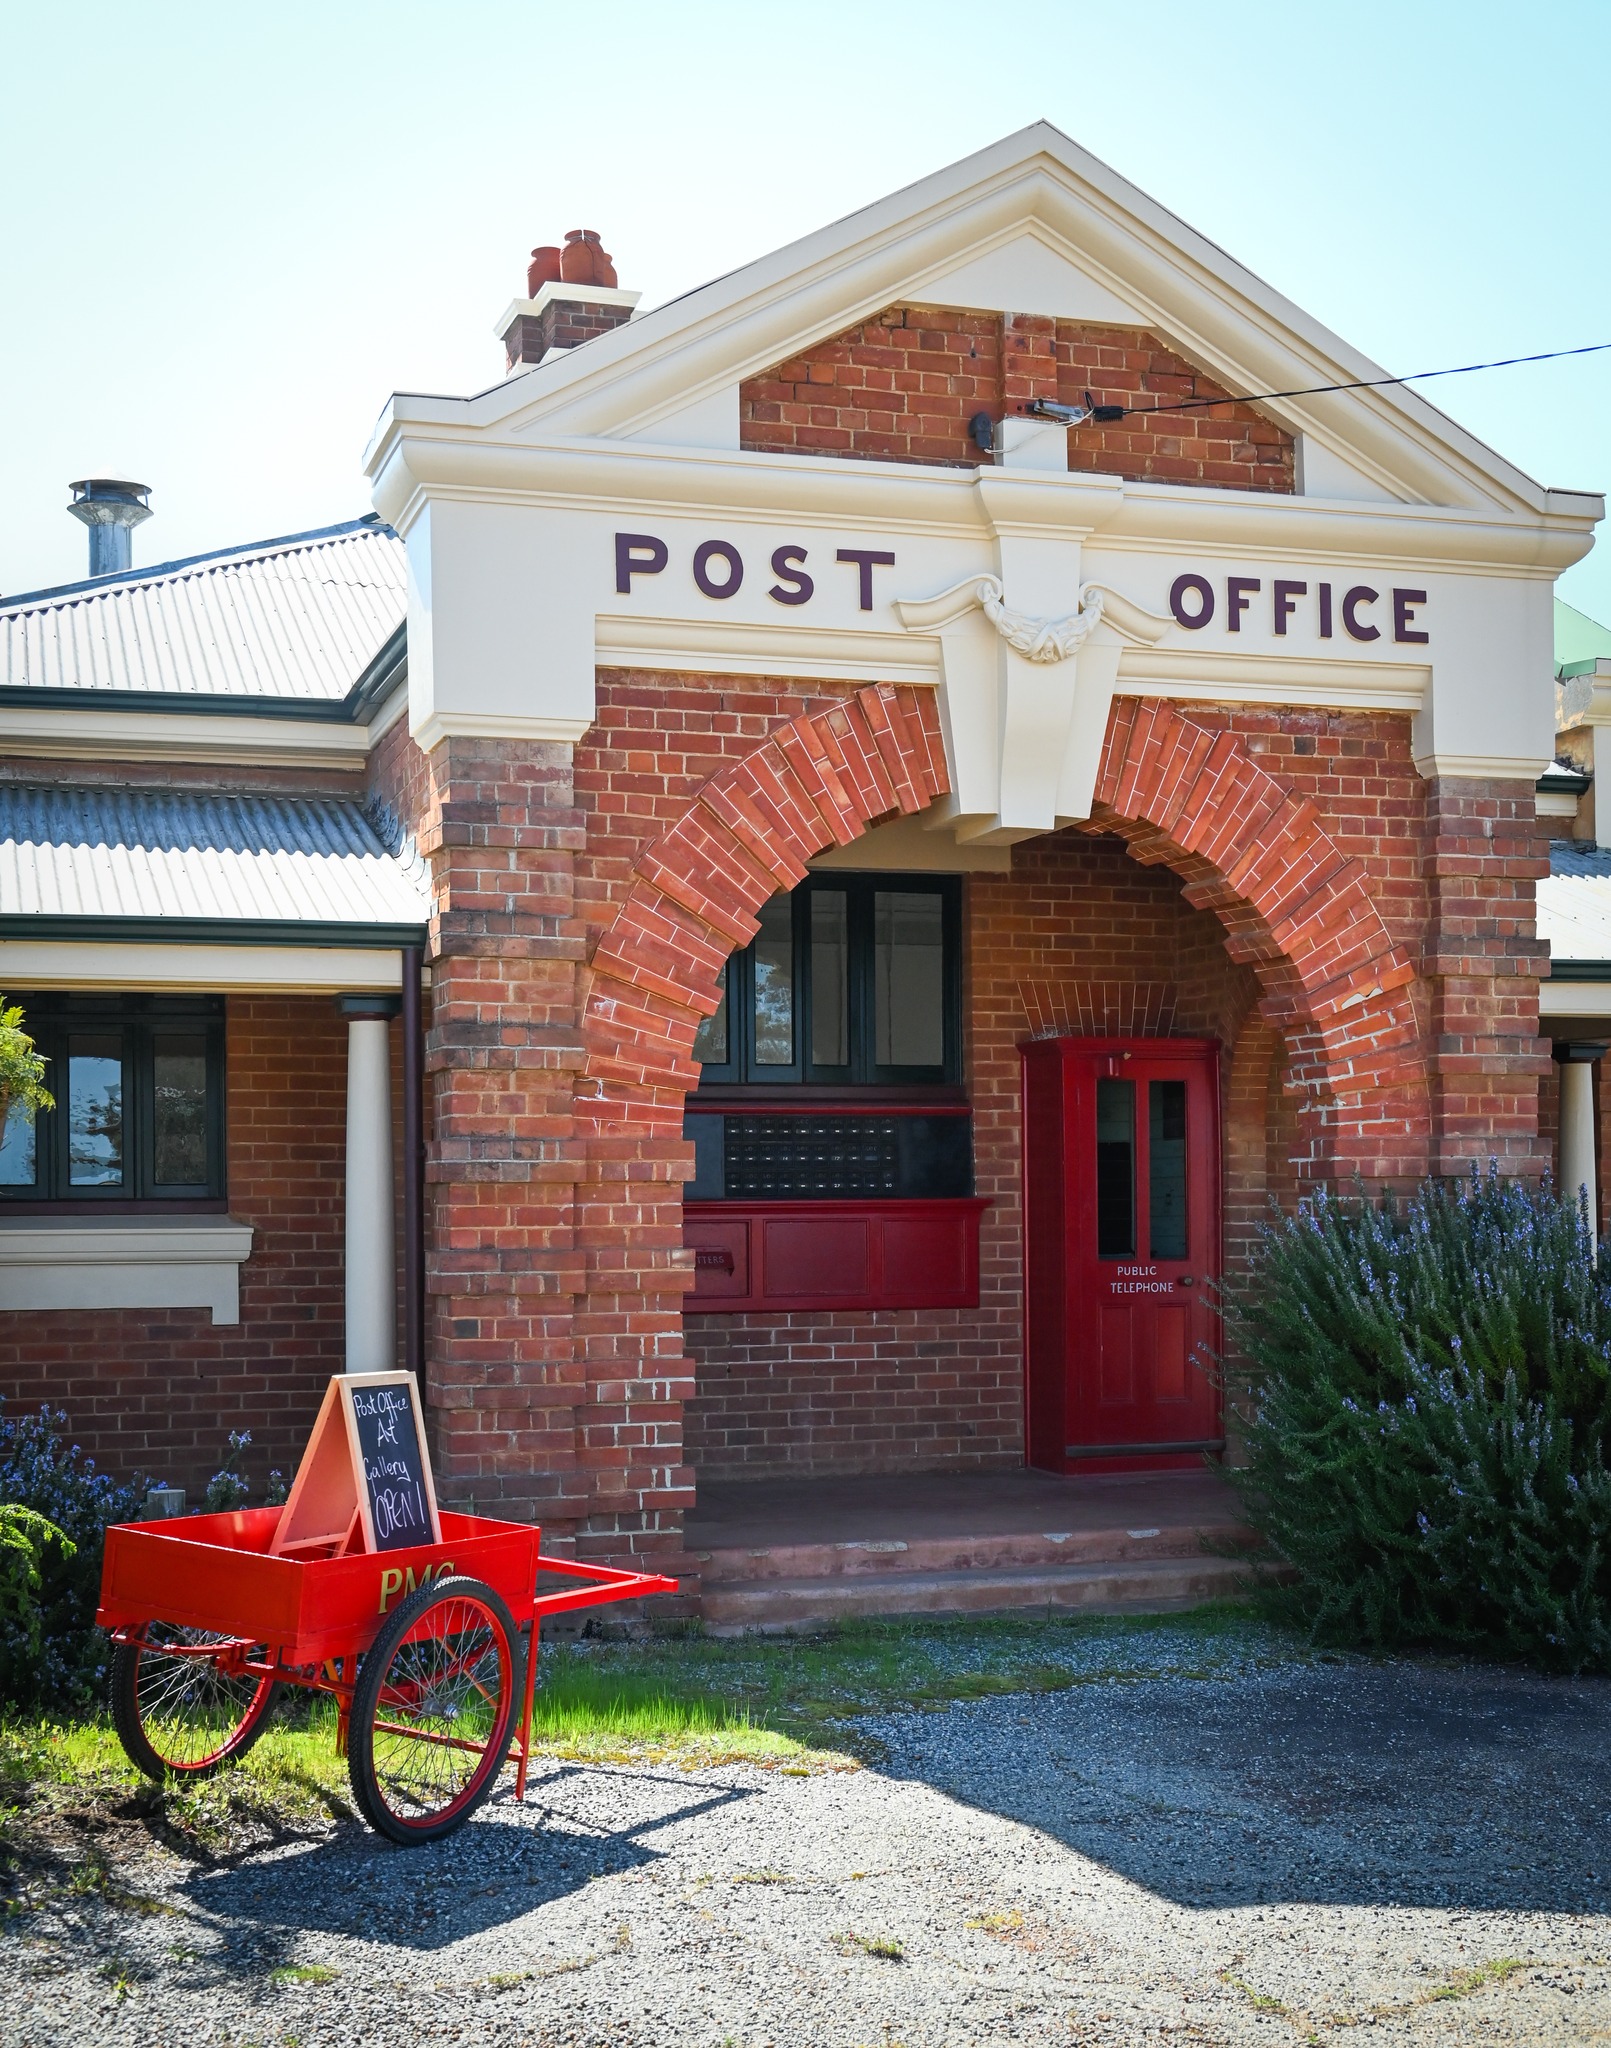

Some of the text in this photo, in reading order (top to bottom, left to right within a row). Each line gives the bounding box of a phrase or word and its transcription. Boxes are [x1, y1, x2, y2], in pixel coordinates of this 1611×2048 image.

[615, 532, 1431, 645] POST OFFICE
[696, 1255, 725, 1265] TTERS
[1117, 1265, 1157, 1277] PUBLIC
[1110, 1282, 1174, 1294] TELEPHONE
[353, 1391, 409, 1423] Post Office
[363, 1456, 412, 1497] Gallery
